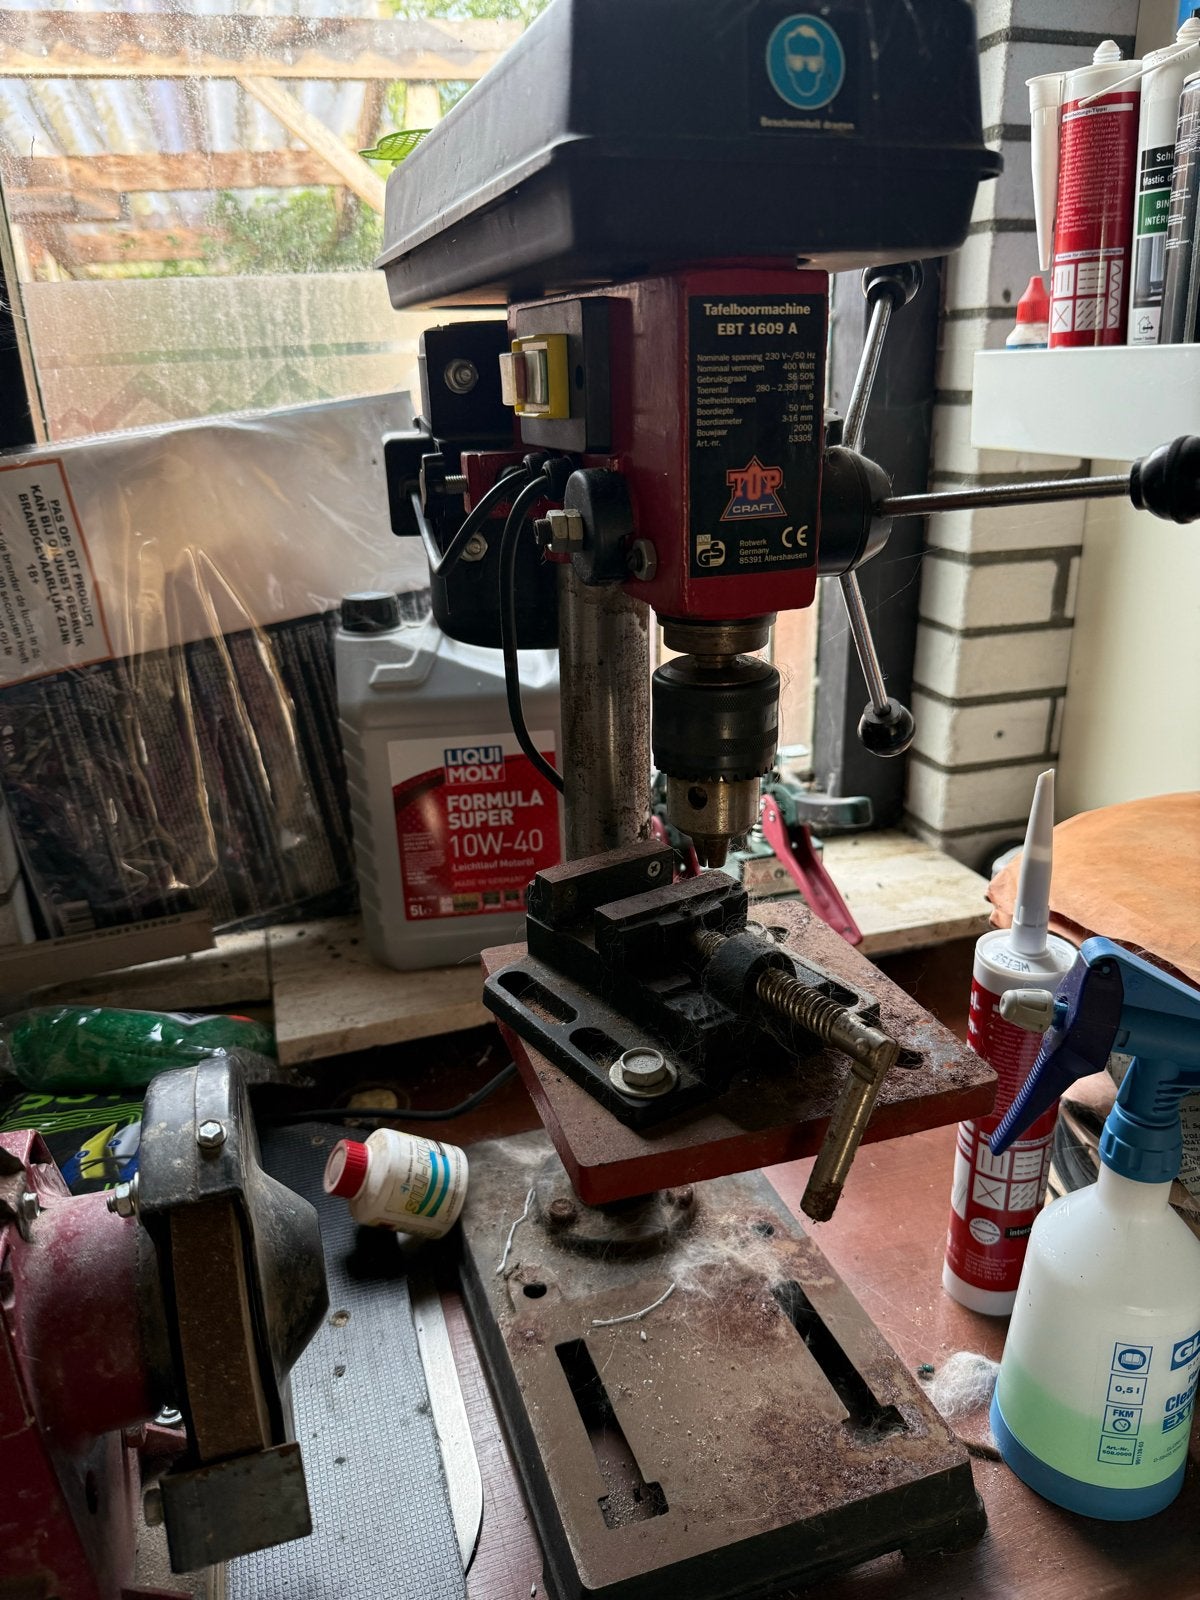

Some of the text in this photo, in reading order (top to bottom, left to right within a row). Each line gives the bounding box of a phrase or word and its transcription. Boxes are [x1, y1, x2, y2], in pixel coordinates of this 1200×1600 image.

[1143, 175, 1164, 187] Mastic
[704, 304, 810, 316] Tafelboormachine
[717, 321, 798, 336] EBT 1609 A
[697, 354, 730, 362] Nominale
[732, 353, 763, 362] spanning
[765, 352, 780, 360] 230
[697, 364, 730, 372] Nominaal
[732, 364, 765, 373] vermogen
[696, 375, 747, 384] Gebruiksgraad
[696, 386, 728, 394] Toerental
[756, 384, 770, 392] 280
[696, 396, 756, 406] Snelheidstrappen
[696, 408, 734, 416] Boordiepte
[788, 404, 798, 412] 50
[696, 418, 742, 426] Boordiameter
[696, 424, 812, 438] Bouwjaar 2000
[696, 434, 812, 448] Art.-nr. 53305
[728, 465, 781, 500] TOP
[732, 504, 774, 514] CRAFT
[740, 539, 767, 547] Rotwerk
[782, 525, 808, 548] CE
[740, 548, 769, 556] Germany
[740, 552, 808, 564] 85391 Allershausen
[17, 493, 73, 646] BRANDGEVAARLIJK ZIJN!
[29, 483, 47, 513] KAN
[39, 514, 55, 537] BIJ
[62, 595, 88, 646] GEBRUIK
[49, 498, 97, 628] PAS OP: DIT PRODUCT
[2, 553, 22, 593] brander
[26, 563, 41, 586] 18+
[15, 594, 26, 608] de
[0, 590, 22, 639] seconden
[15, 640, 30, 664] heeft
[20, 608, 36, 635] lucht
[0, 631, 10, 646] op
[29, 636, 38, 646] in
[4, 646, 14, 656] te
[446, 747, 502, 764] LIQUI
[448, 765, 503, 784] MOLY
[447, 790, 544, 812] FORMULA
[448, 810, 514, 830] SUPER
[450, 828, 544, 858] 10W-40
[452, 860, 498, 872] Leichtlauf
[500, 858, 534, 870] Motoröl
[992, 952, 1031, 973] WEISS
[1115, 1385, 1134, 1394] 0,5
[1112, 1408, 1134, 1418] FKM
